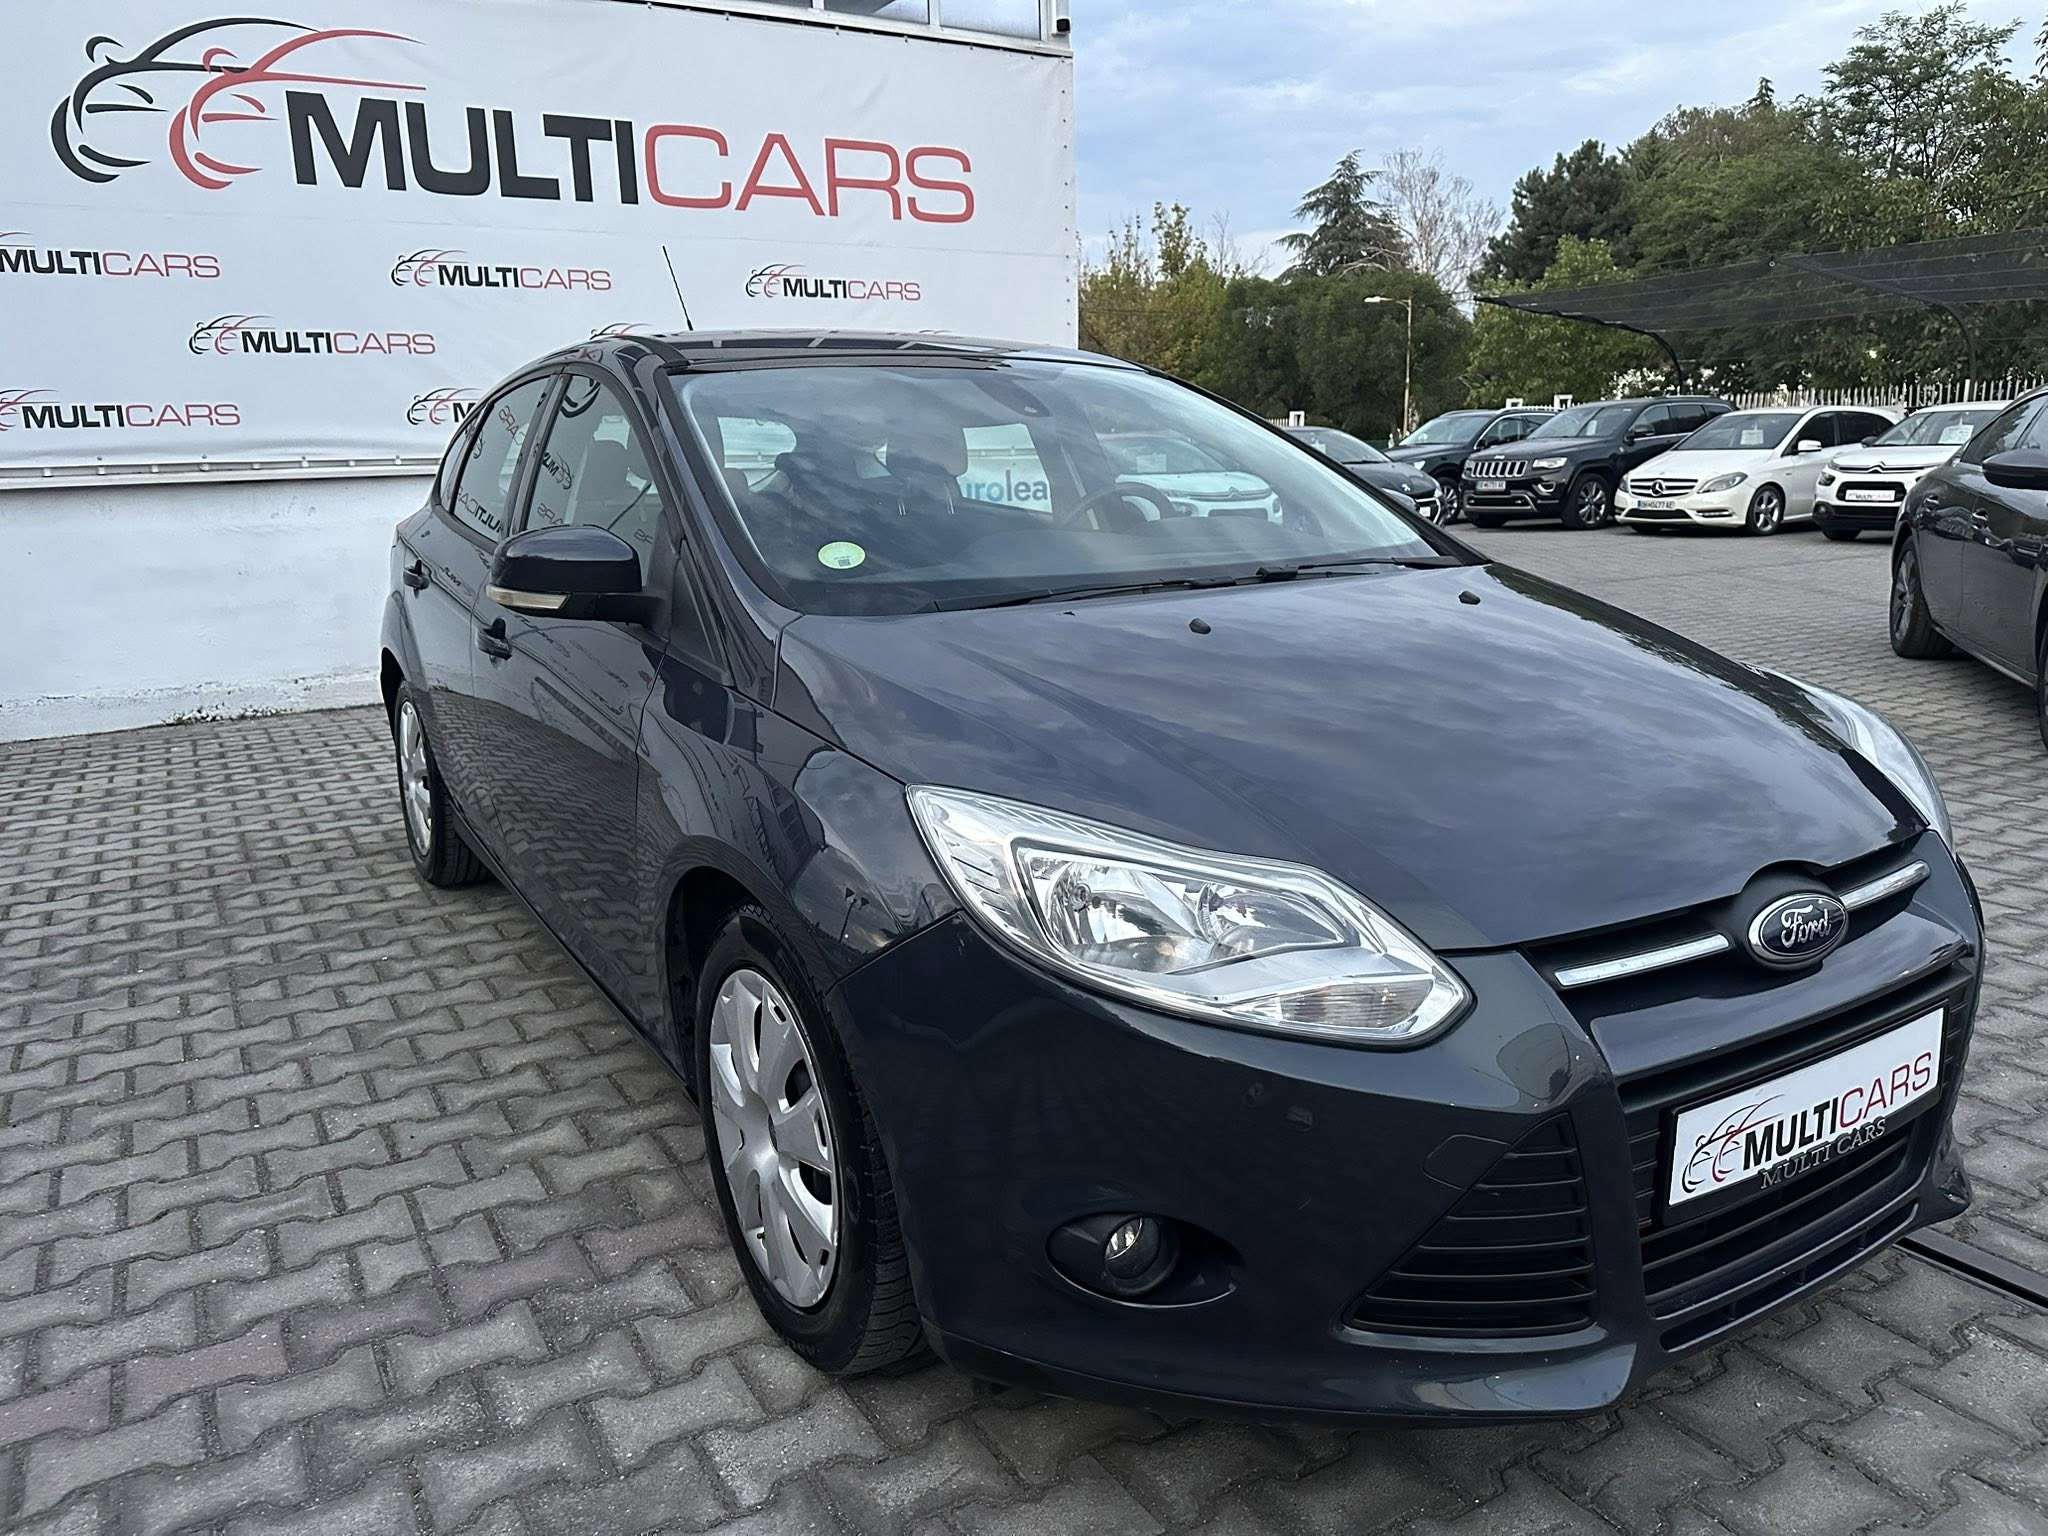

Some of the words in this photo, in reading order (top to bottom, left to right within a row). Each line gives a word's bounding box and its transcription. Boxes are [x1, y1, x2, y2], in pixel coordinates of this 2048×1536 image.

[285, 89, 975, 224] MULTICARS
[0, 248, 220, 279] MULTICARS
[437, 263, 611, 291] MULTICARS
[782, 276, 921, 302] MULTICARS
[242, 331, 436, 355] MULTICARS
[22, 404, 241, 429] MULTICARS
[1781, 904, 1831, 949] Ford
[1743, 1051, 1932, 1171] MULTICARS
[1760, 1142, 1832, 1190] MULTI
[1836, 1119, 1887, 1156] CARS
